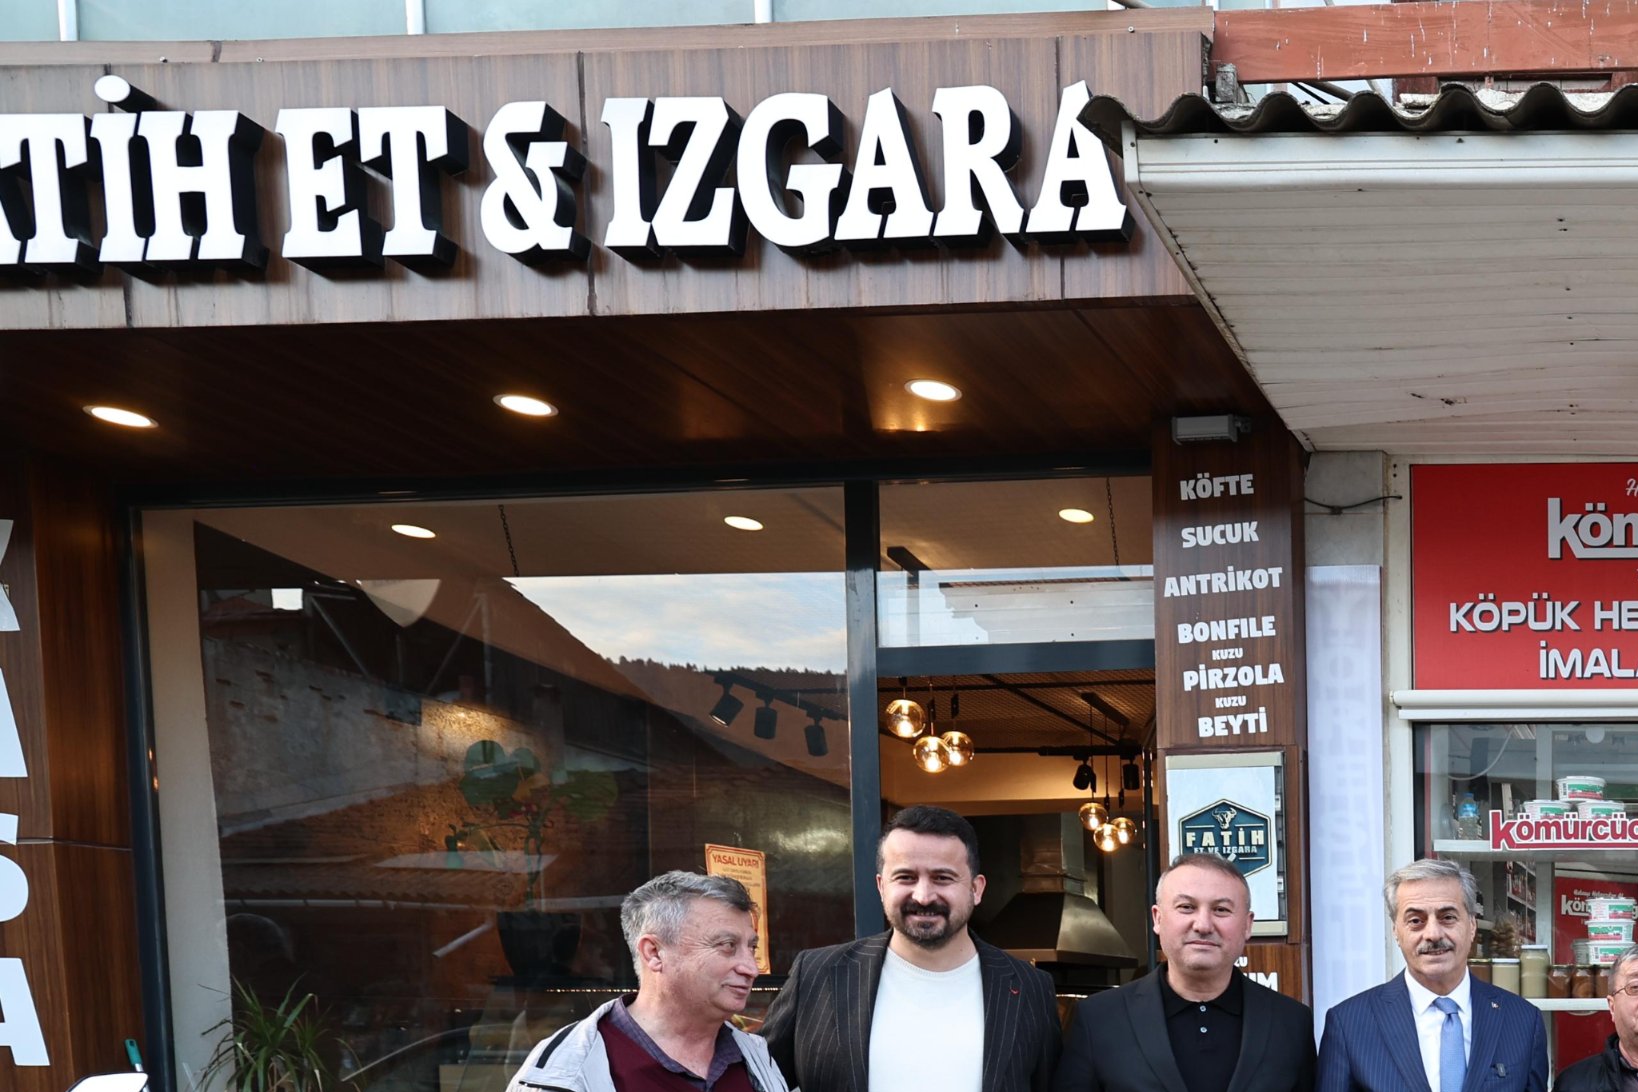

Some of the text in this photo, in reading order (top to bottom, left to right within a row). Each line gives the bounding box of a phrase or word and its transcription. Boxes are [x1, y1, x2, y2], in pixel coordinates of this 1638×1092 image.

[275, 106, 449, 258] ET
[480, 101, 575, 254] &
[601, 80, 1127, 248] IZGARA
[1180, 472, 1255, 501] KÖFTE
[1181, 521, 1259, 548] SUCUK
[1164, 566, 1283, 597] ANTRİKOT
[1449, 592, 1580, 632] KÖPÜK
[1177, 615, 1276, 644] BONFILE
[1211, 647, 1243, 660] KUZU
[1183, 663, 1284, 691] PİRZOLA
[1215, 695, 1247, 708] KUZU
[1198, 706, 1268, 737] BEYTİ
[1186, 827, 1264, 848] FATİH
[1222, 845, 1258, 854] IZGARA
[712, 854, 737, 866] YASAL
